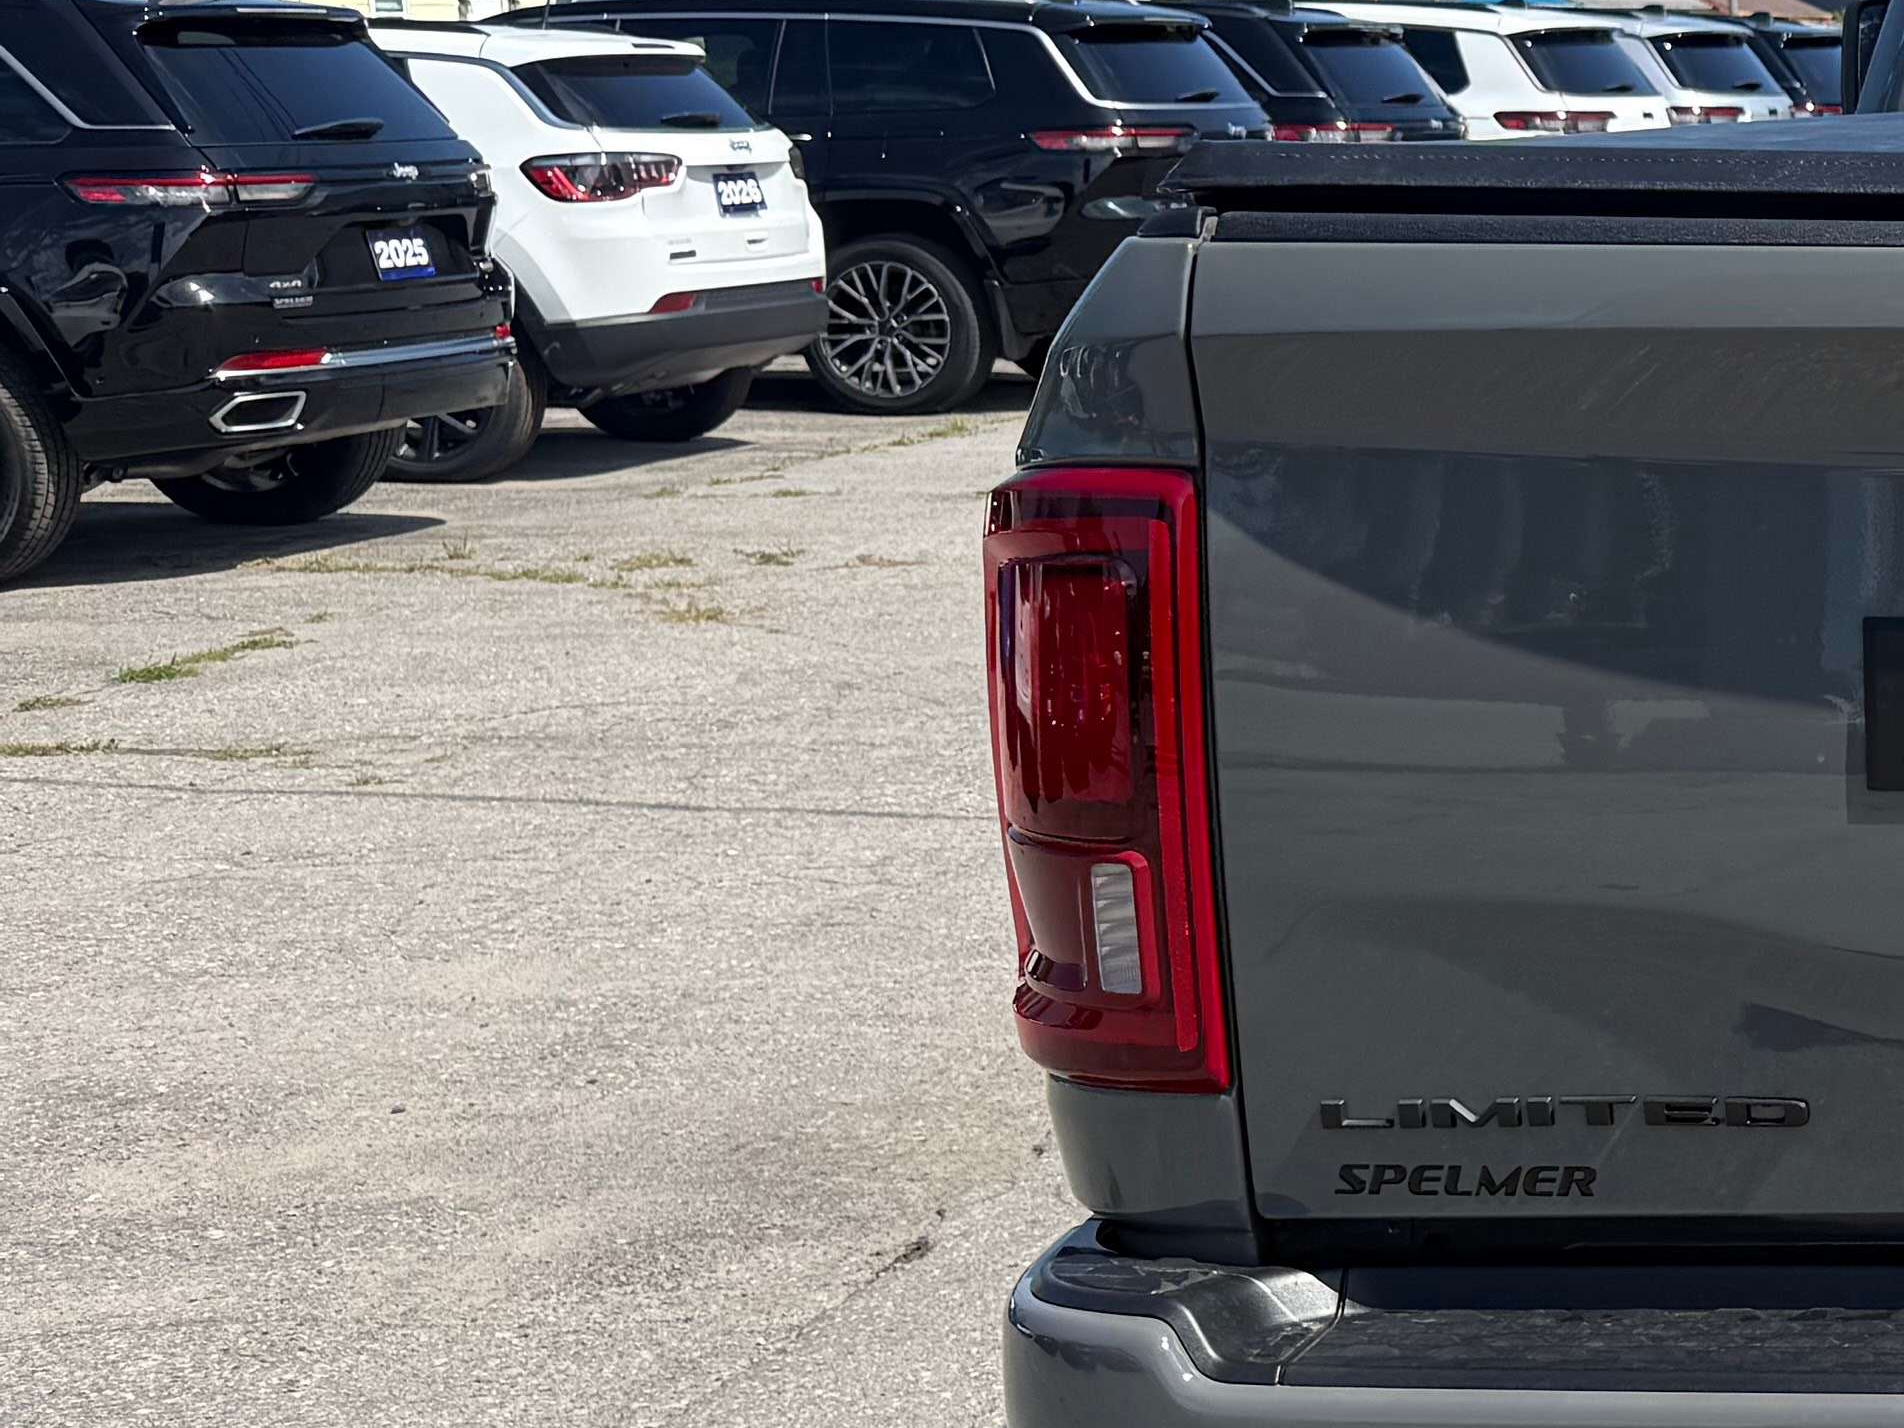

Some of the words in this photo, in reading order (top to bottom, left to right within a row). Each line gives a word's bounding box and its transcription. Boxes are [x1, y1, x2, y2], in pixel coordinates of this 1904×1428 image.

[374, 238, 429, 269] 2025
[1320, 1094, 1811, 1129] LIMITED
[1334, 1163, 1598, 1198] SPELMER
